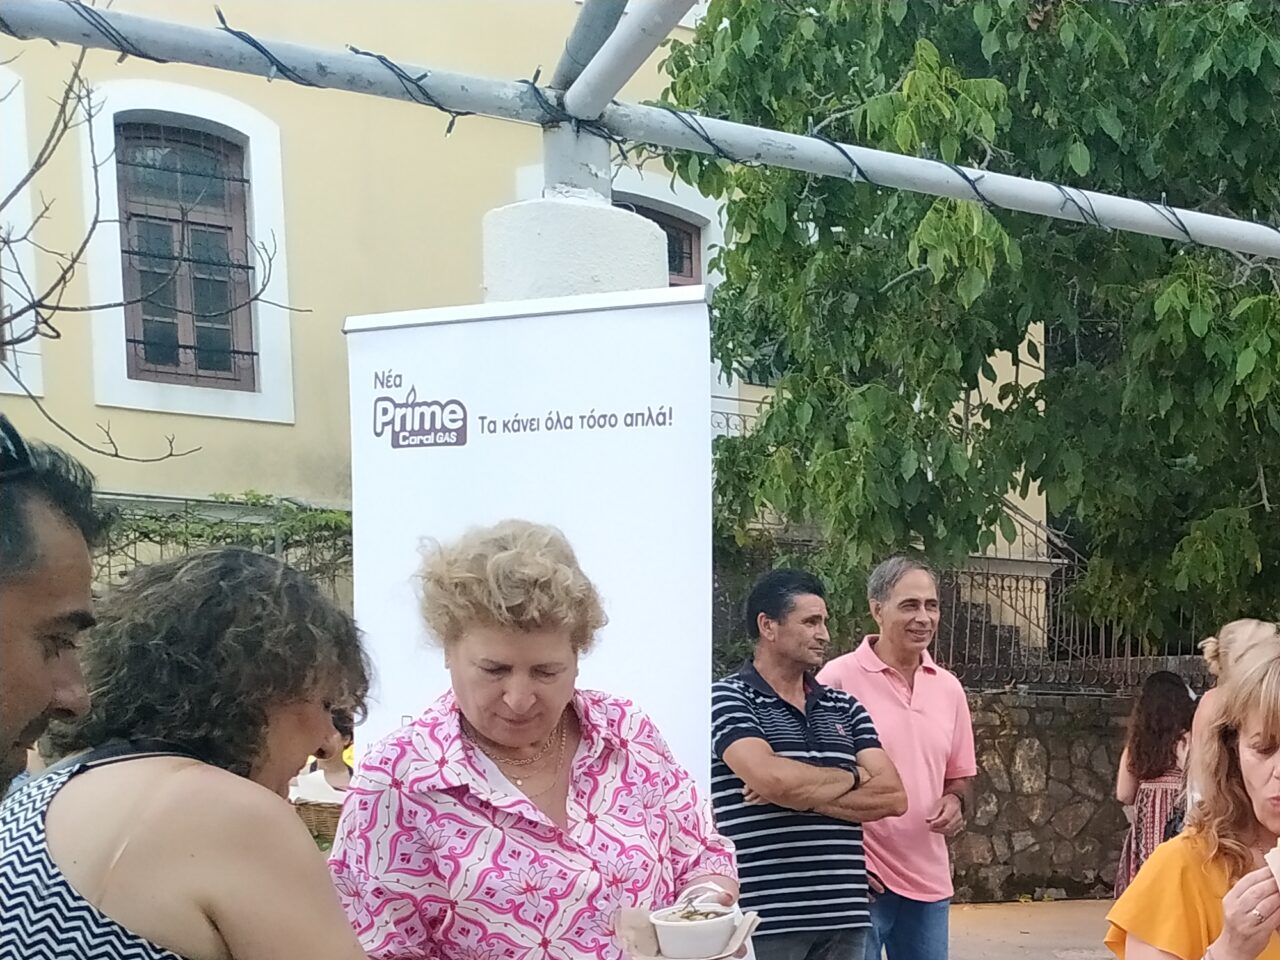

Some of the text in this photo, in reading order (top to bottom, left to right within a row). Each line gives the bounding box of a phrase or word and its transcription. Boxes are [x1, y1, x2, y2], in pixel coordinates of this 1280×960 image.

[374, 369, 402, 389] Νέα
[375, 397, 465, 435] Prime
[478, 405, 673, 434] Τα κάνει όλα τόσο απλά!
[399, 431, 457, 445] Coral GAS
